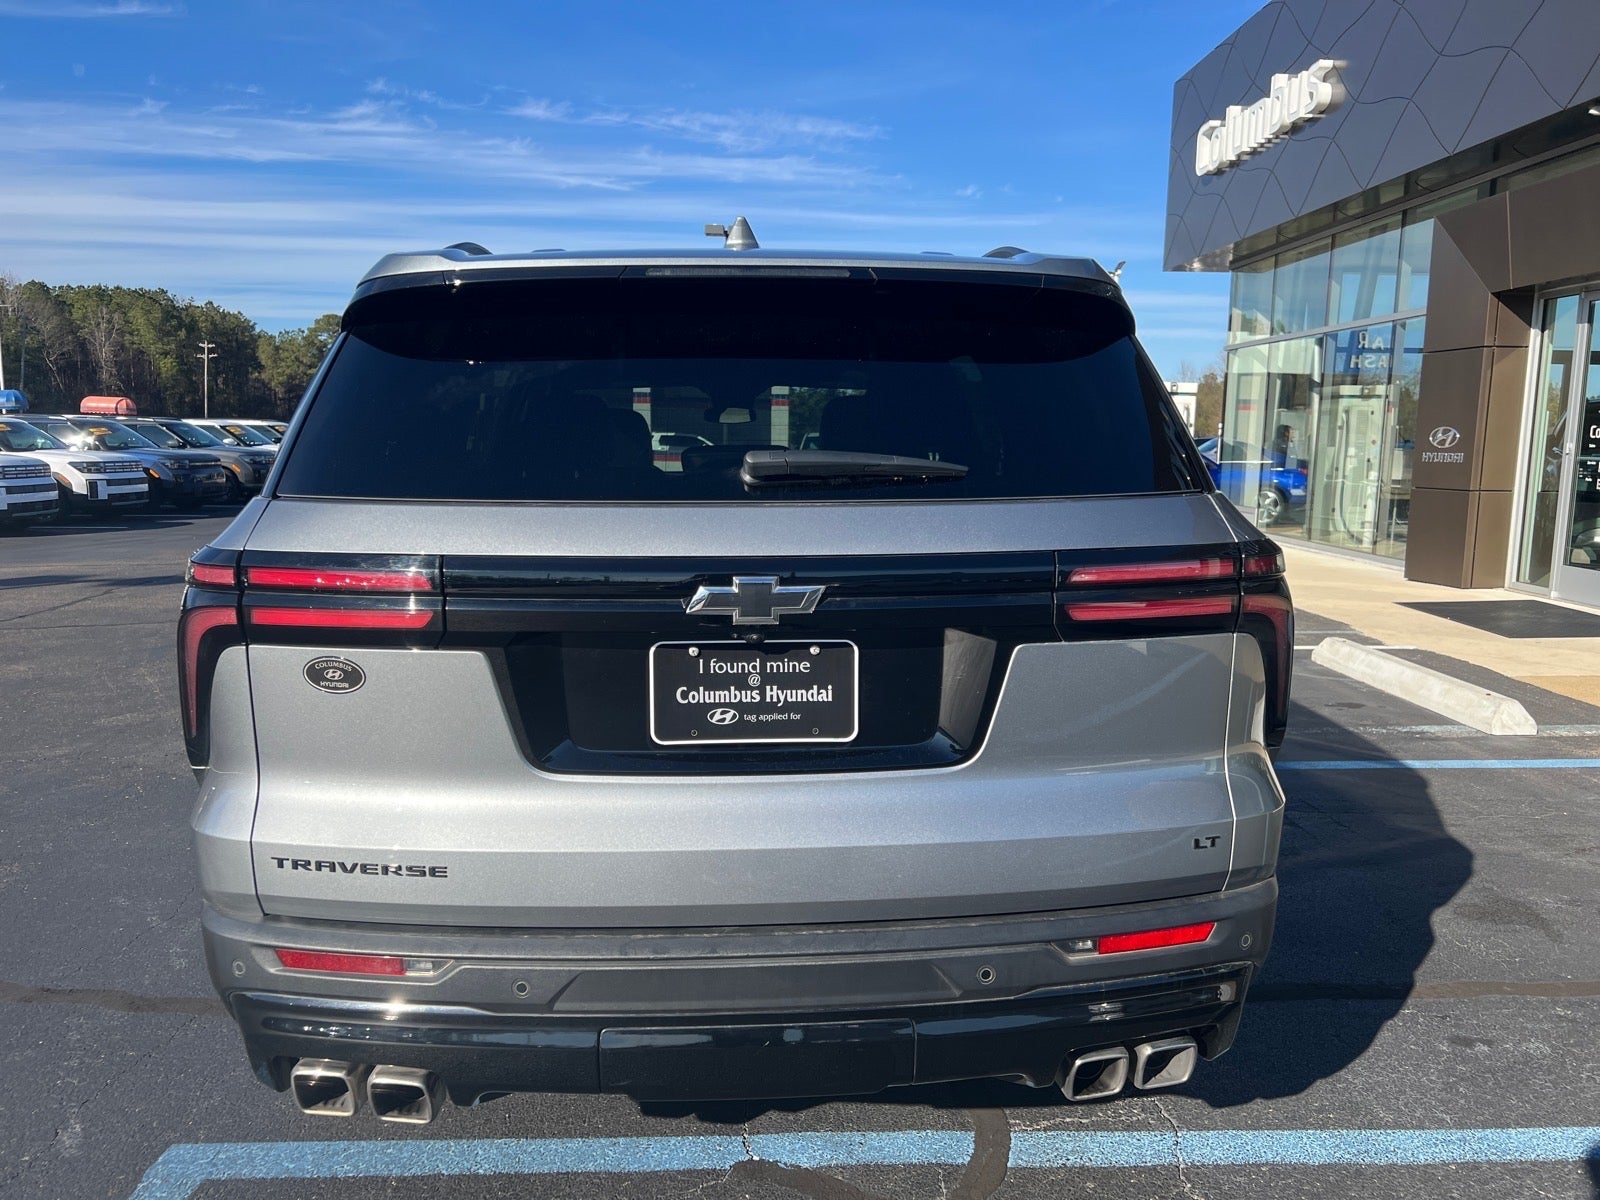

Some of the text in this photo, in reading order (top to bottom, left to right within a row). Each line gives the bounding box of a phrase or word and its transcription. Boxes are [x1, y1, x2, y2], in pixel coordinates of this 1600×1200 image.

[1422, 452, 1464, 463] HYUNDAI
[315, 661, 352, 671] COLUMBUS
[699, 658, 811, 674] I found mine
[748, 674, 761, 687] @
[675, 685, 833, 706] Columbus Hyundai
[743, 712, 801, 722] tag applied for
[1193, 836, 1221, 849] LT
[270, 856, 448, 878] TRAVERSE
